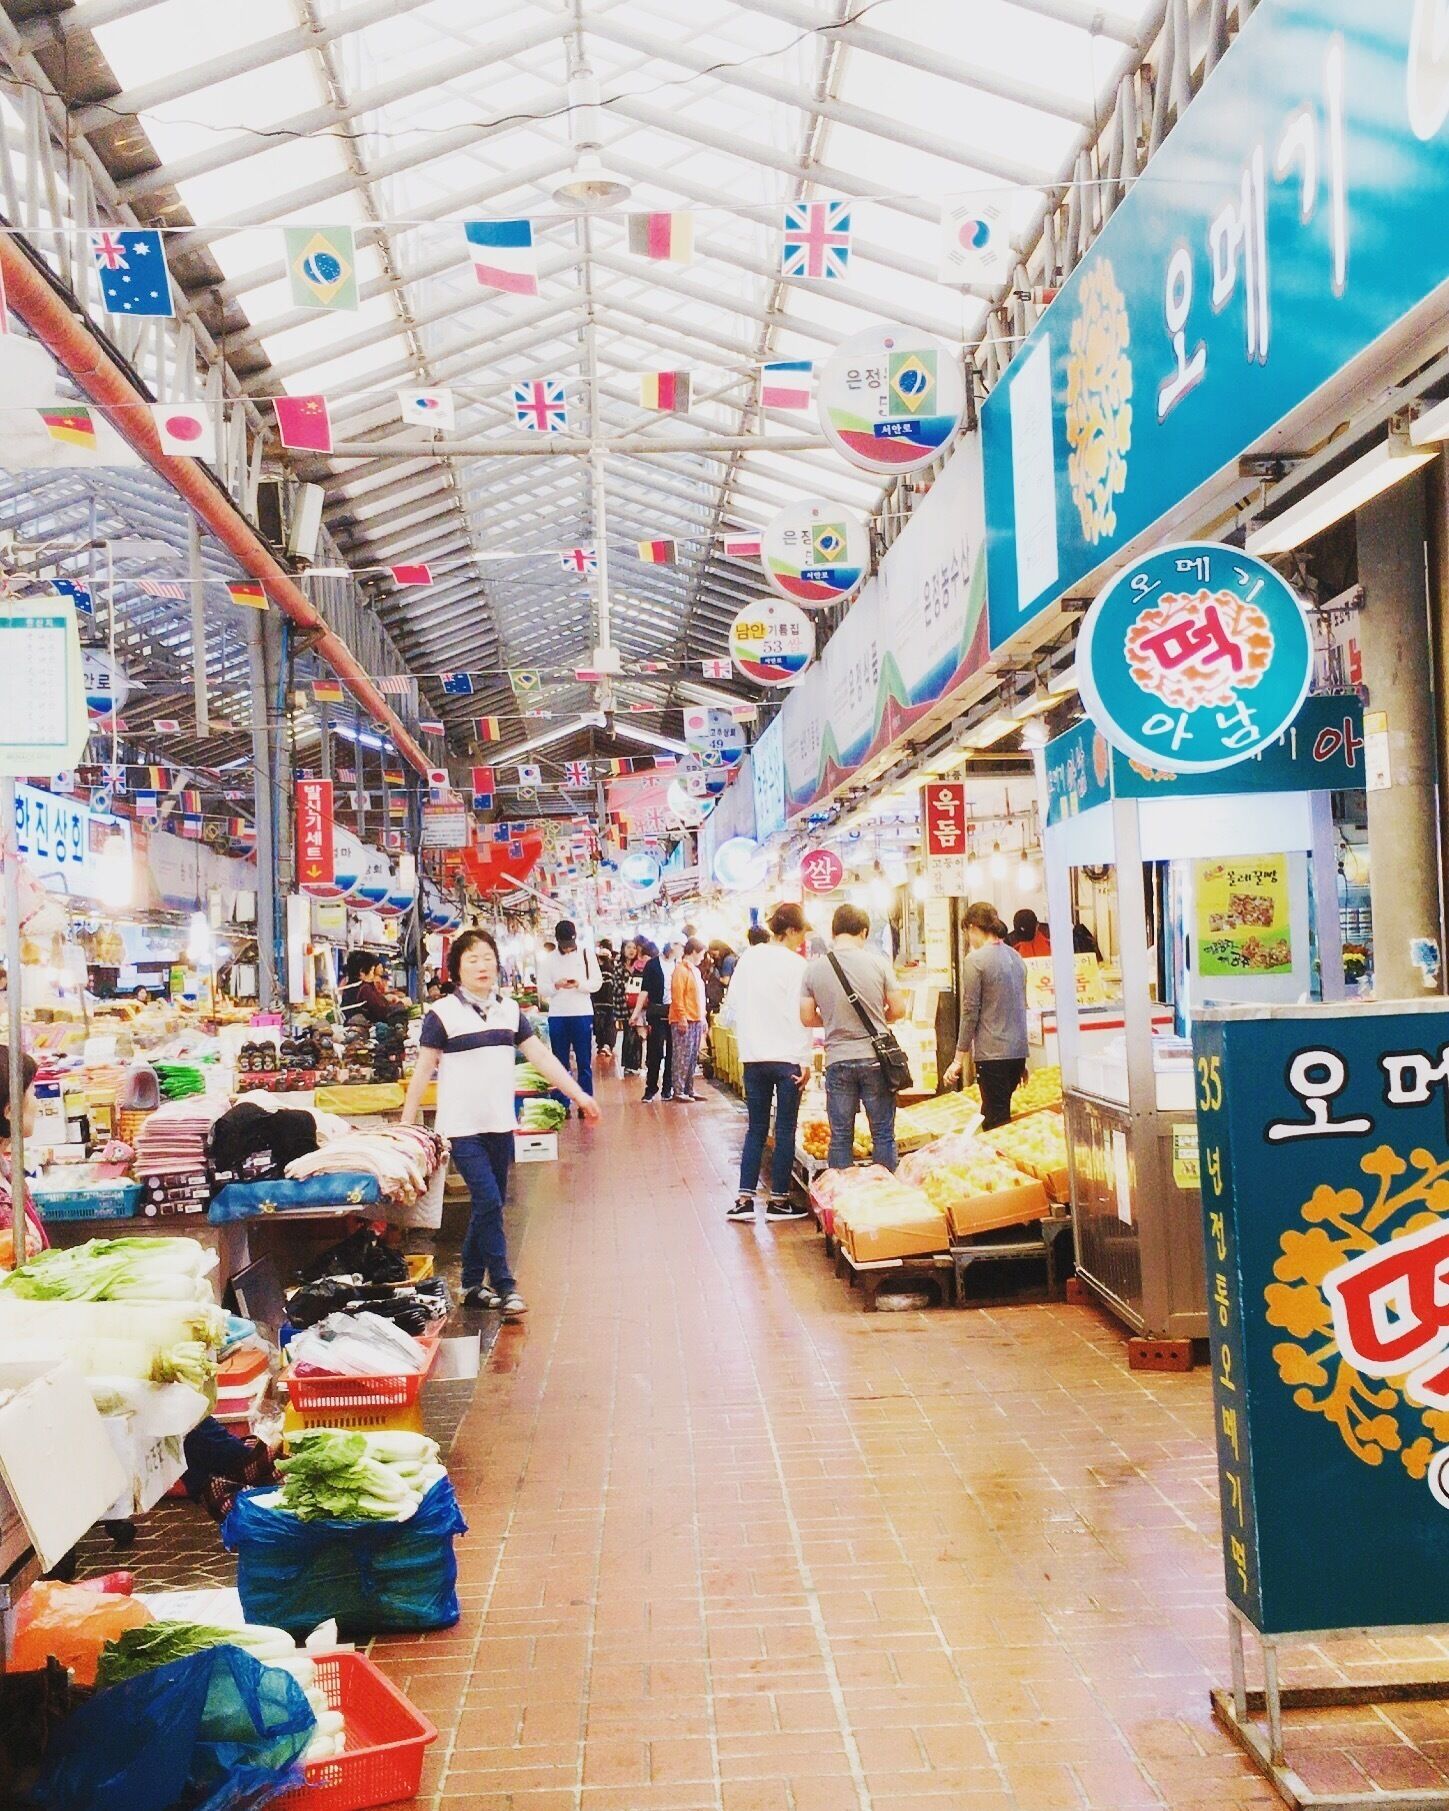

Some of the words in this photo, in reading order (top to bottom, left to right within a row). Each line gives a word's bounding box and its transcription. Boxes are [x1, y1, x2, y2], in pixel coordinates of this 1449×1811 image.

[1131, 556, 1265, 604] 오메기
[1140, 605, 1243, 672] 떡
[1141, 701, 1261, 751] 아남
[16, 795, 84, 864] 한진상회
[303, 785, 323, 861] 발신기세트
[932, 788, 961, 848] 옥돔
[805, 855, 838, 889] 쌀
